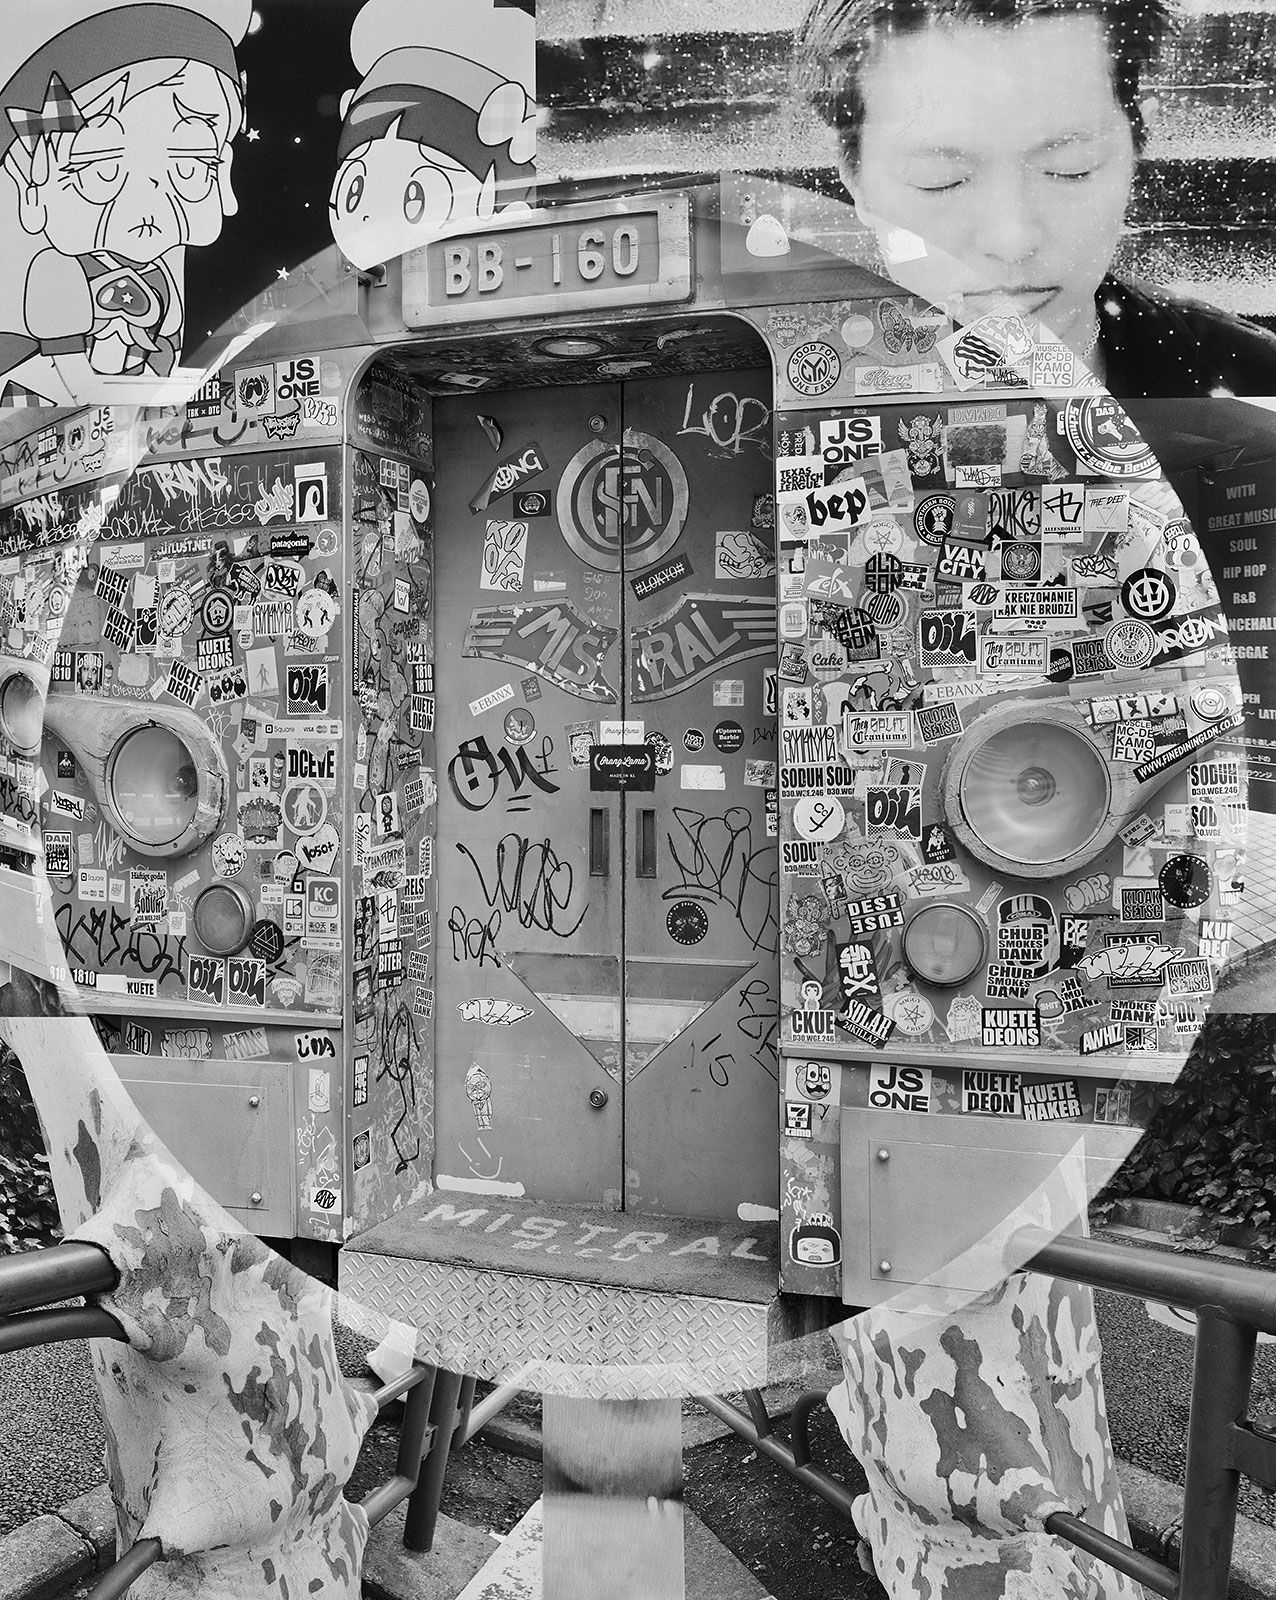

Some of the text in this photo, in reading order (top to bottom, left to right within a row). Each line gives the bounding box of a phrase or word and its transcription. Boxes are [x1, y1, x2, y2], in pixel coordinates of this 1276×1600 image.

[791, 344, 837, 365] GOOD FOR
[281, 358, 314, 383] JS
[1034, 362, 1072, 372] KAMO
[792, 374, 837, 394] ONE FARE
[1033, 373, 1072, 385] FLYS
[277, 379, 320, 399] ONE
[1095, 406, 1115, 417] DAS
[828, 418, 873, 445] JS
[822, 443, 880, 463] ONE
[780, 466, 812, 478] TEXAS
[780, 473, 824, 485] SCRATCH
[778, 481, 822, 493] LEAGUE
[1225, 483, 1257, 500] WITH
[805, 488, 867, 527] bep
[1208, 513, 1241, 529] GREAT
[271, 540, 308, 550] patagonia
[944, 544, 985, 563] VAN
[1229, 538, 1258, 553] SOUL
[99, 564, 130, 594] KUETE
[1223, 563, 1267, 579] HIP HOP
[96, 581, 123, 609] DEON
[1232, 591, 1257, 604] R&B
[1020, 603, 1074, 615] NIE BRUDZI
[106, 605, 136, 638] KUETE
[103, 621, 130, 651] DEON
[199, 636, 231, 656] KUETE
[198, 652, 234, 672] DEONS
[811, 652, 844, 667] Cake
[171, 659, 204, 695] KUETE
[165, 677, 197, 709] DEON
[936, 682, 984, 699] EBANX
[412, 695, 434, 715] KUETE
[478, 689, 513, 711] EBANX
[274, 724, 295, 735] Square
[413, 712, 433, 731] DEON
[1115, 736, 1154, 750] KAMO
[1114, 746, 1153, 763] FLYS
[781, 767, 824, 788] SODUH
[404, 779, 424, 796] CHUB
[406, 796, 425, 812] DANK
[46, 834, 70, 842] DAN
[314, 887, 334, 902] KC
[847, 894, 898, 917] DEST
[998, 927, 1043, 940] CHUB
[998, 939, 1043, 949] SMOKES
[378, 953, 402, 973] BITER
[409, 952, 428, 965] CHUB
[998, 948, 1043, 961] DANK
[72, 968, 96, 986] 1810
[408, 969, 426, 982] DANK
[988, 964, 1034, 979] CHUB
[126, 981, 155, 995] KUETE
[987, 976, 1031, 989] SMOKES
[415, 987, 433, 1001] CHUB
[413, 1004, 431, 1018] DANK
[1039, 1002, 1060, 1012] SHIT
[1111, 1001, 1156, 1012] SMOKES
[984, 1009, 1037, 1029] KUETE
[1110, 1010, 1154, 1024] DANK
[983, 1028, 1040, 1046] DEONS
[877, 1066, 924, 1093] JS
[964, 1071, 1020, 1093] KUETE
[1022, 1080, 1076, 1105] KUETE
[869, 1090, 929, 1113] ONE
[967, 1092, 1015, 1113] DEON
[418, 1205, 769, 1262] MISTRAL
